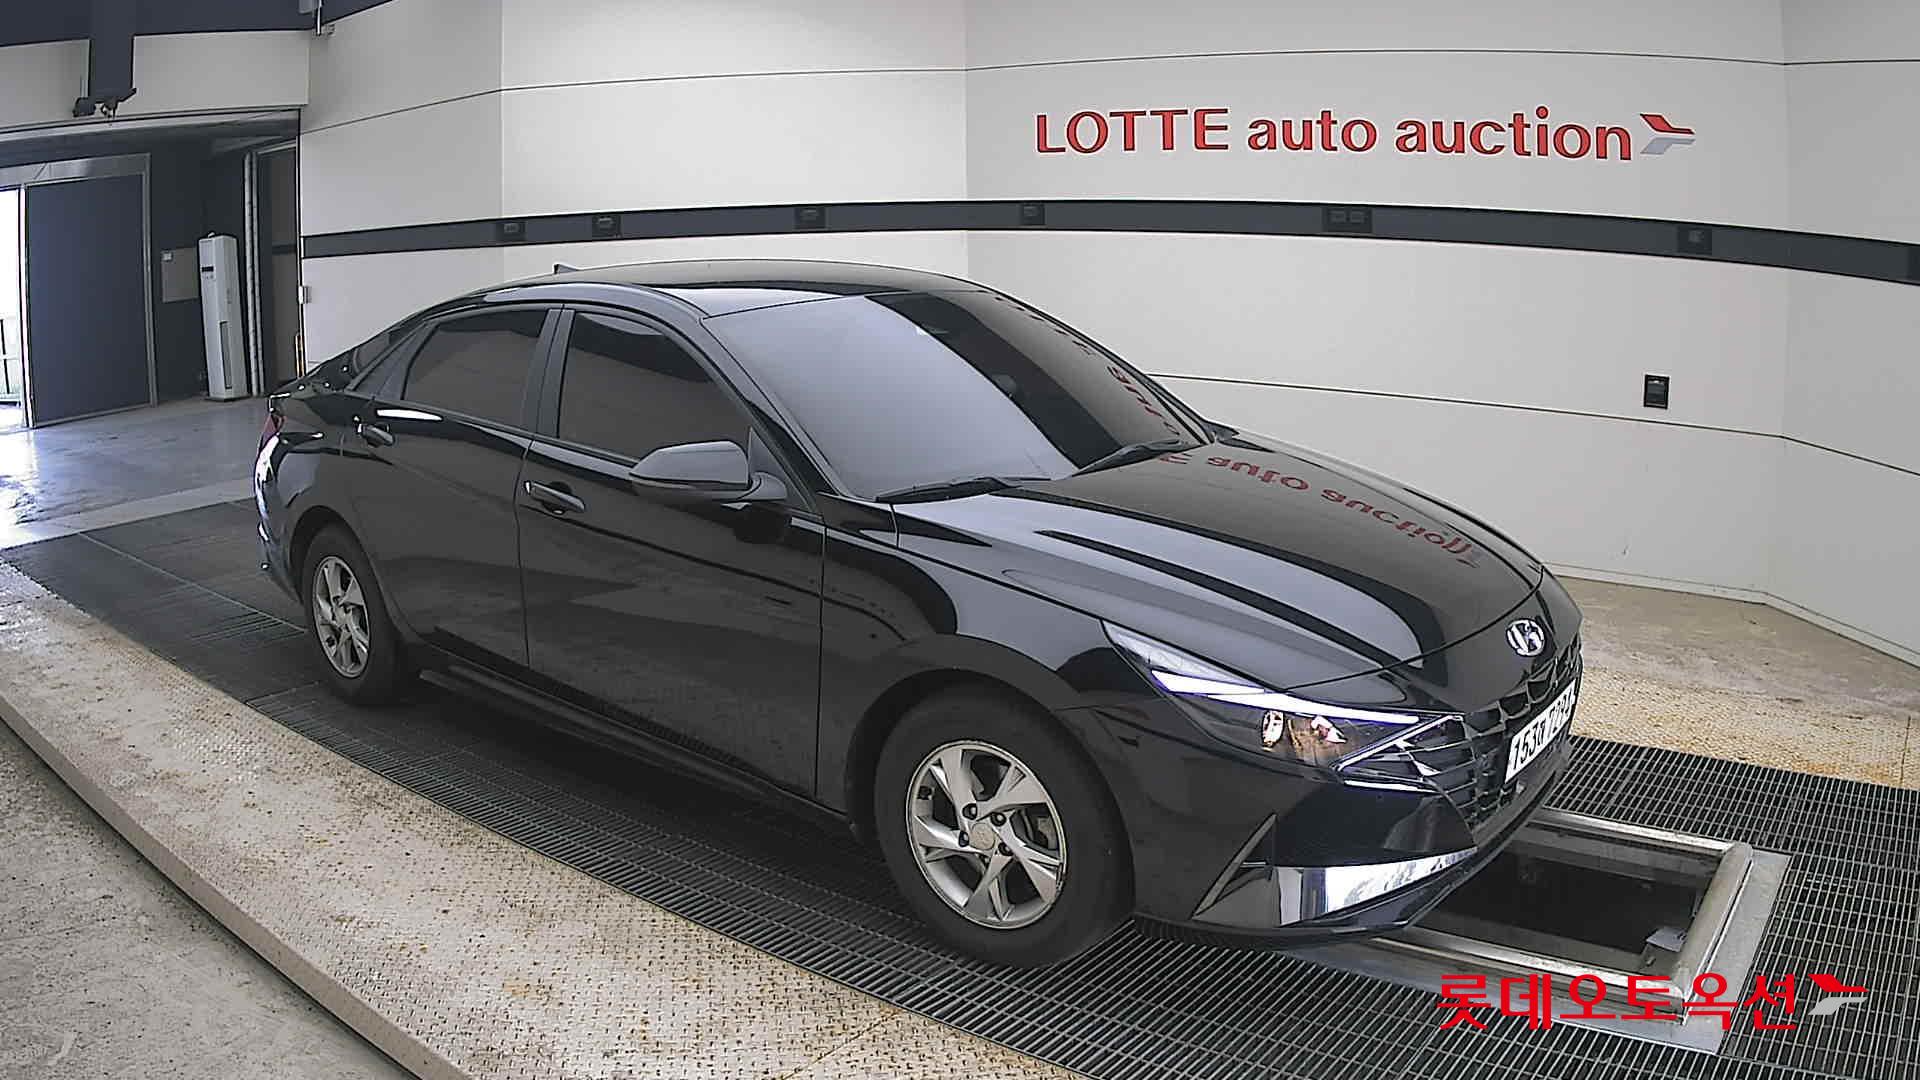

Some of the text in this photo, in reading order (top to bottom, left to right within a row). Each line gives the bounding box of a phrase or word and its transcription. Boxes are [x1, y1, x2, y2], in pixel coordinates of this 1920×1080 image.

[1036, 106, 1632, 161] LOTTE auto auction
